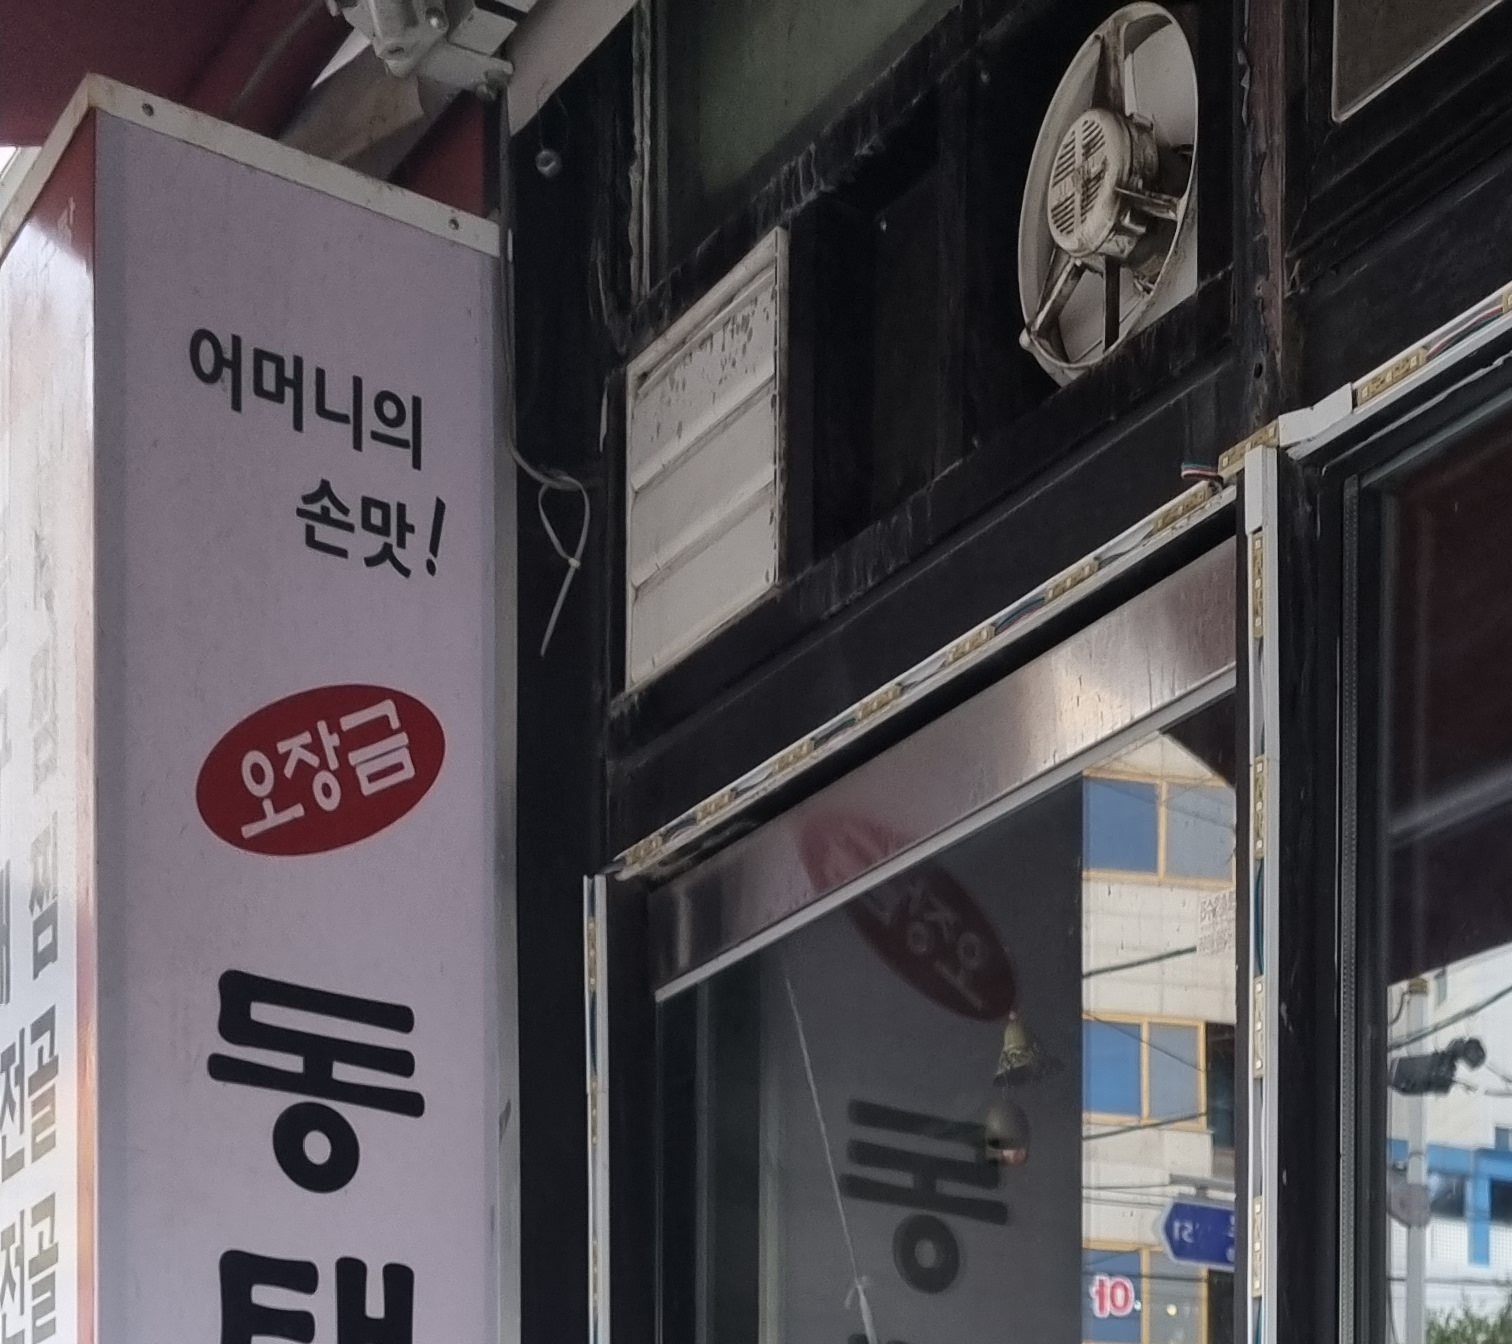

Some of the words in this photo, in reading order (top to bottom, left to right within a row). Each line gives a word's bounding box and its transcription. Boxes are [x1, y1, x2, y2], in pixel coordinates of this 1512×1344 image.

[188, 327, 426, 470] 어머니의
[295, 478, 446, 579] 손맛!
[240, 698, 417, 840] 오장금
